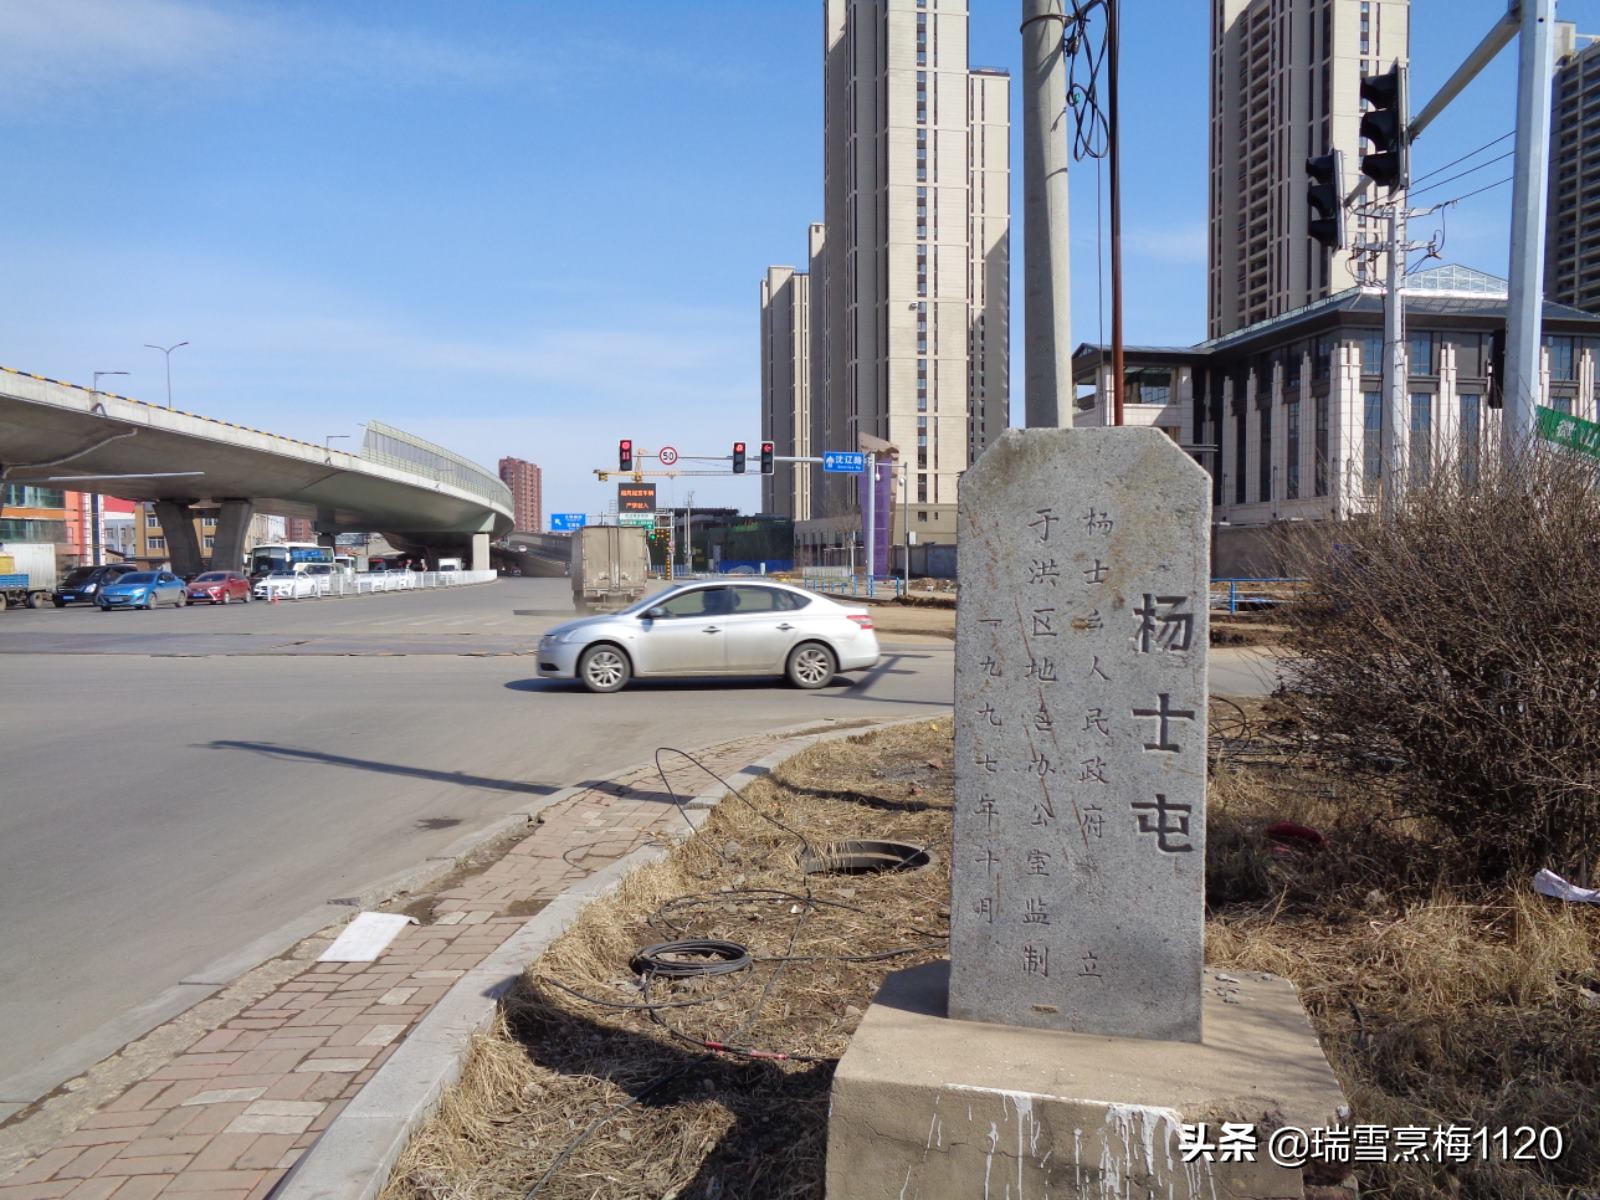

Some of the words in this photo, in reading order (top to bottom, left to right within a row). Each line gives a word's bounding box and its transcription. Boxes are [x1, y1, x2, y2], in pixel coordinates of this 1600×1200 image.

[662, 451, 674, 461] 50
[835, 455, 862, 465] 沈辽路
[974, 617, 1002, 924] 一九九七年十月
[1022, 507, 1060, 978] 于洪区地名办公室监制
[1131, 593, 1196, 853] 杨士屯
